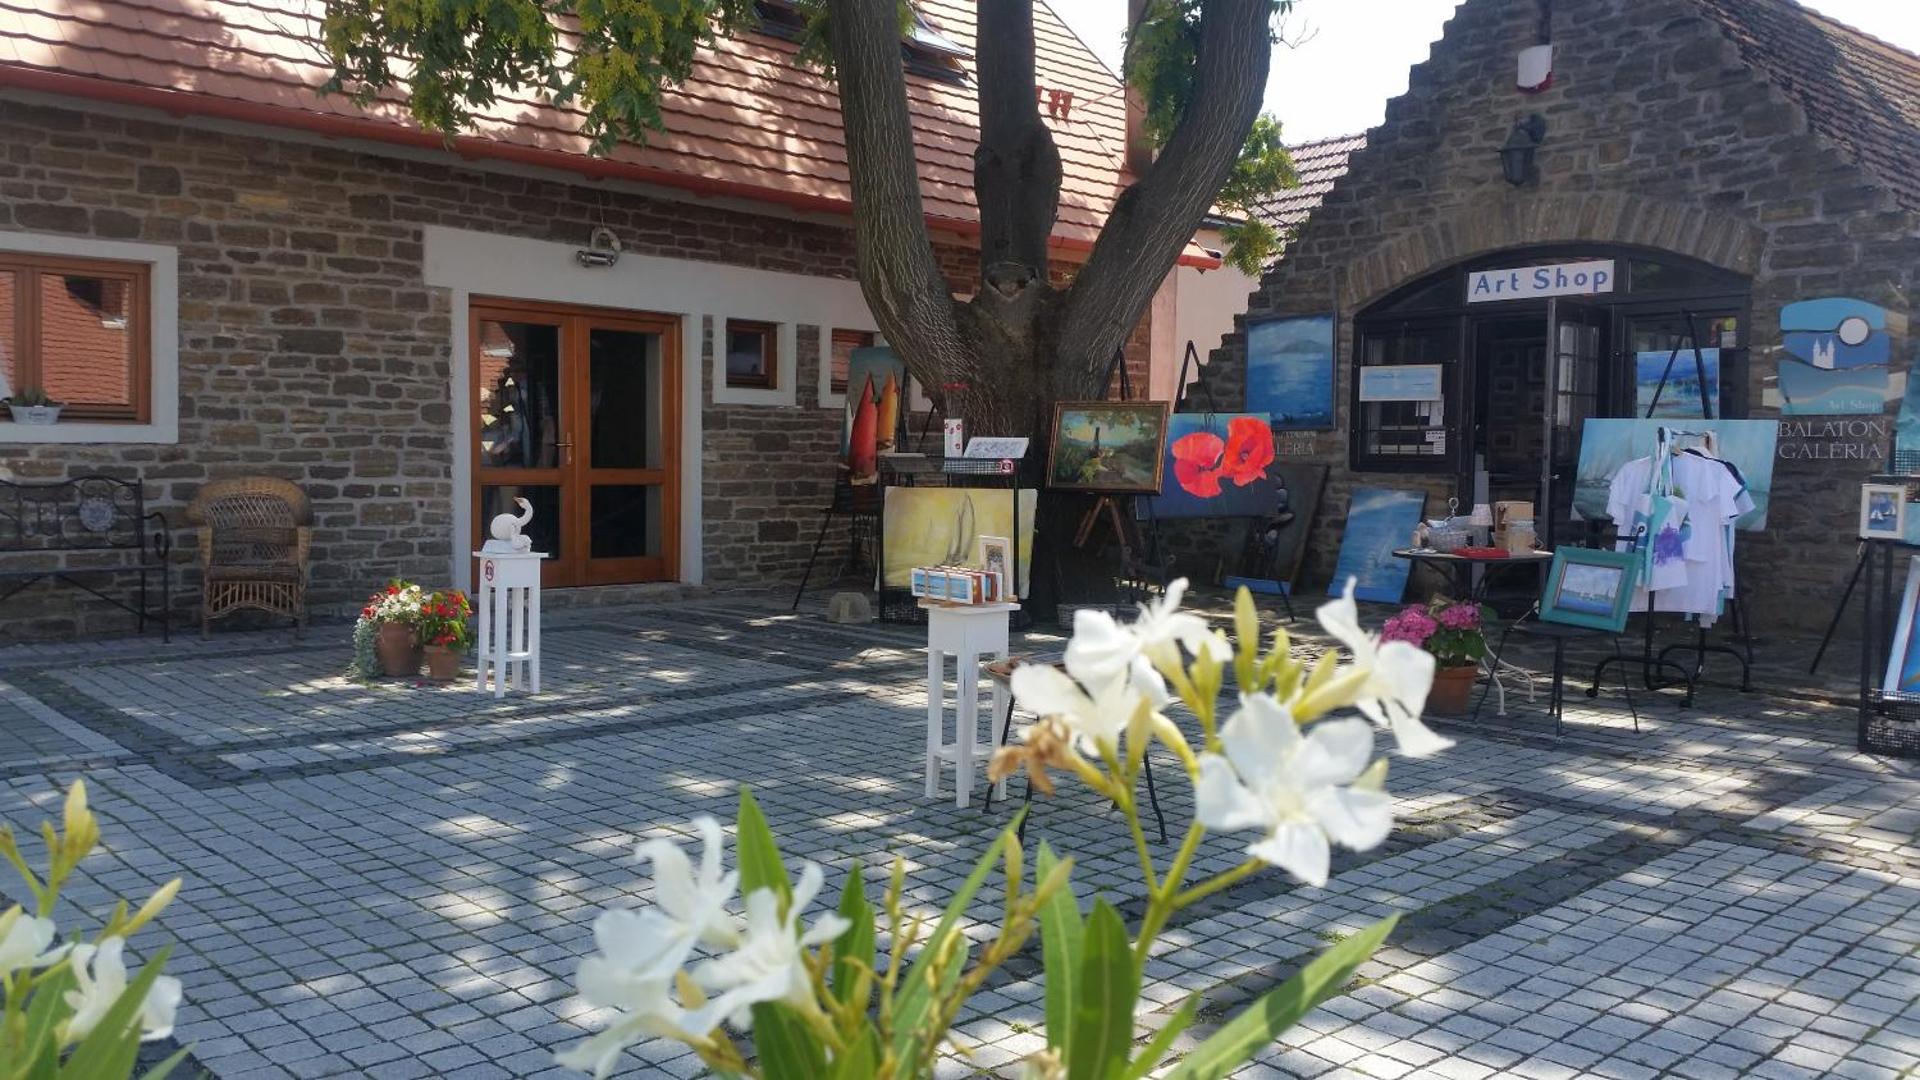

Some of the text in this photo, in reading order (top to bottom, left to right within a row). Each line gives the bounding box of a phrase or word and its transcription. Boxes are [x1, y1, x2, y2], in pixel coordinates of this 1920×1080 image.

[1474, 267, 1608, 294] Art Shop
[1778, 420, 1887, 437] BALATON
